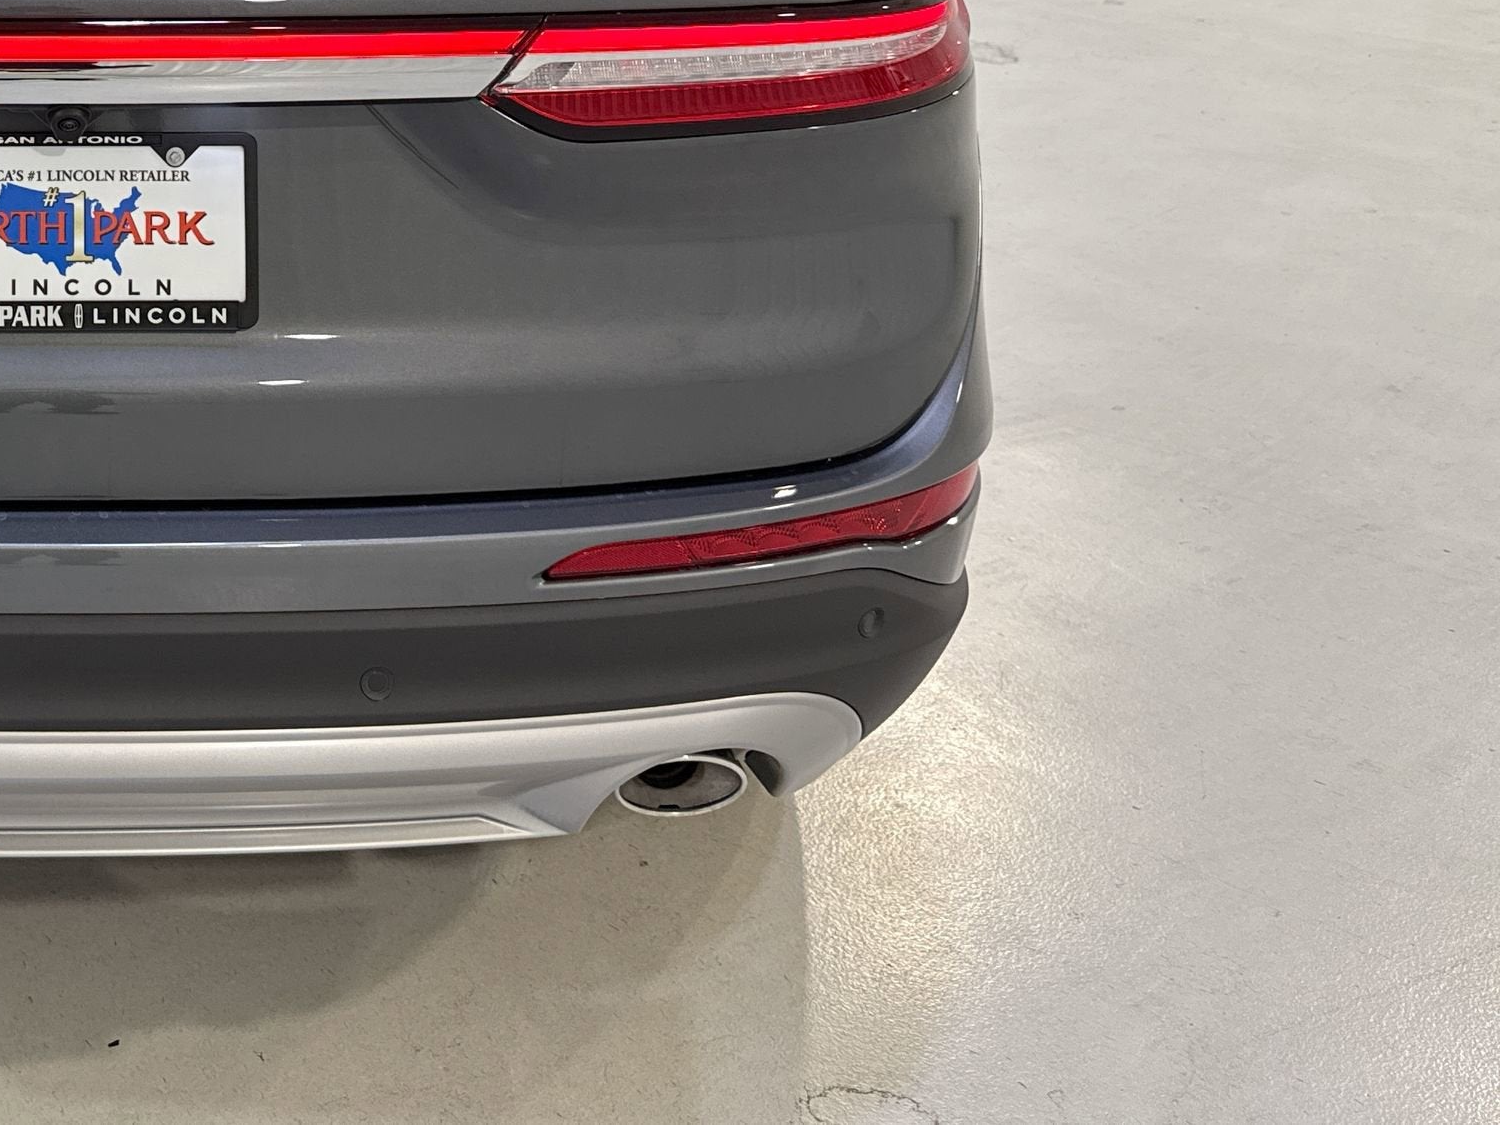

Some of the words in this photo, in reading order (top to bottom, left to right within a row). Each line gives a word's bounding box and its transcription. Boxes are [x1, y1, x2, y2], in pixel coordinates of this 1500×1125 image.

[43, 136, 143, 144] ATONIO
[28, 170, 42, 182] #1
[47, 170, 115, 182] LINCOLN
[119, 170, 190, 182] RETAILER
[92, 211, 215, 246] PARK
[93, 307, 227, 324] LINCOLN
